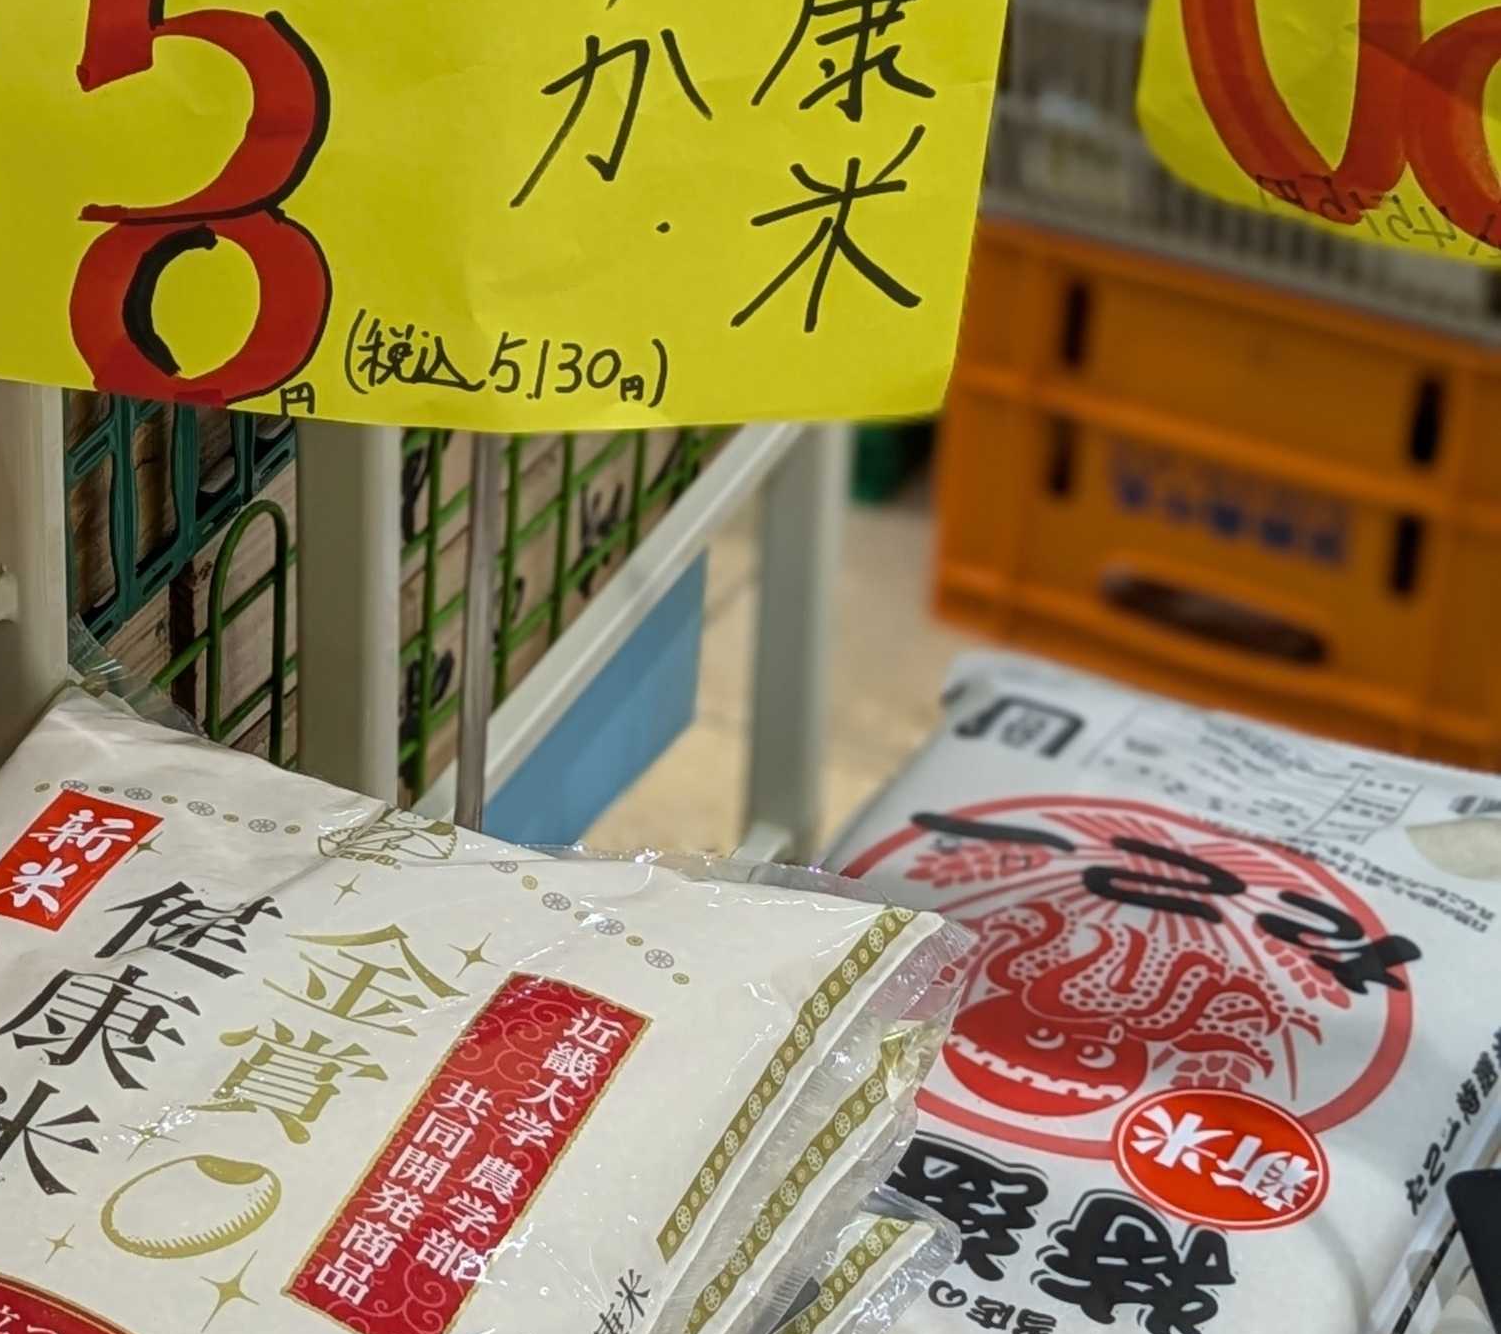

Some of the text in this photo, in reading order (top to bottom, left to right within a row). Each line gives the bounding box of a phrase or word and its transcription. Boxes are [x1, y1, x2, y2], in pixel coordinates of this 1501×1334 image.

[189, 923, 470, 1144] 金賞
[313, 1079, 490, 1304] 共同開発商品
[417, 1008, 619, 1284] 近畿大学 農学部
[1128, 1103, 1321, 1213] 新米
